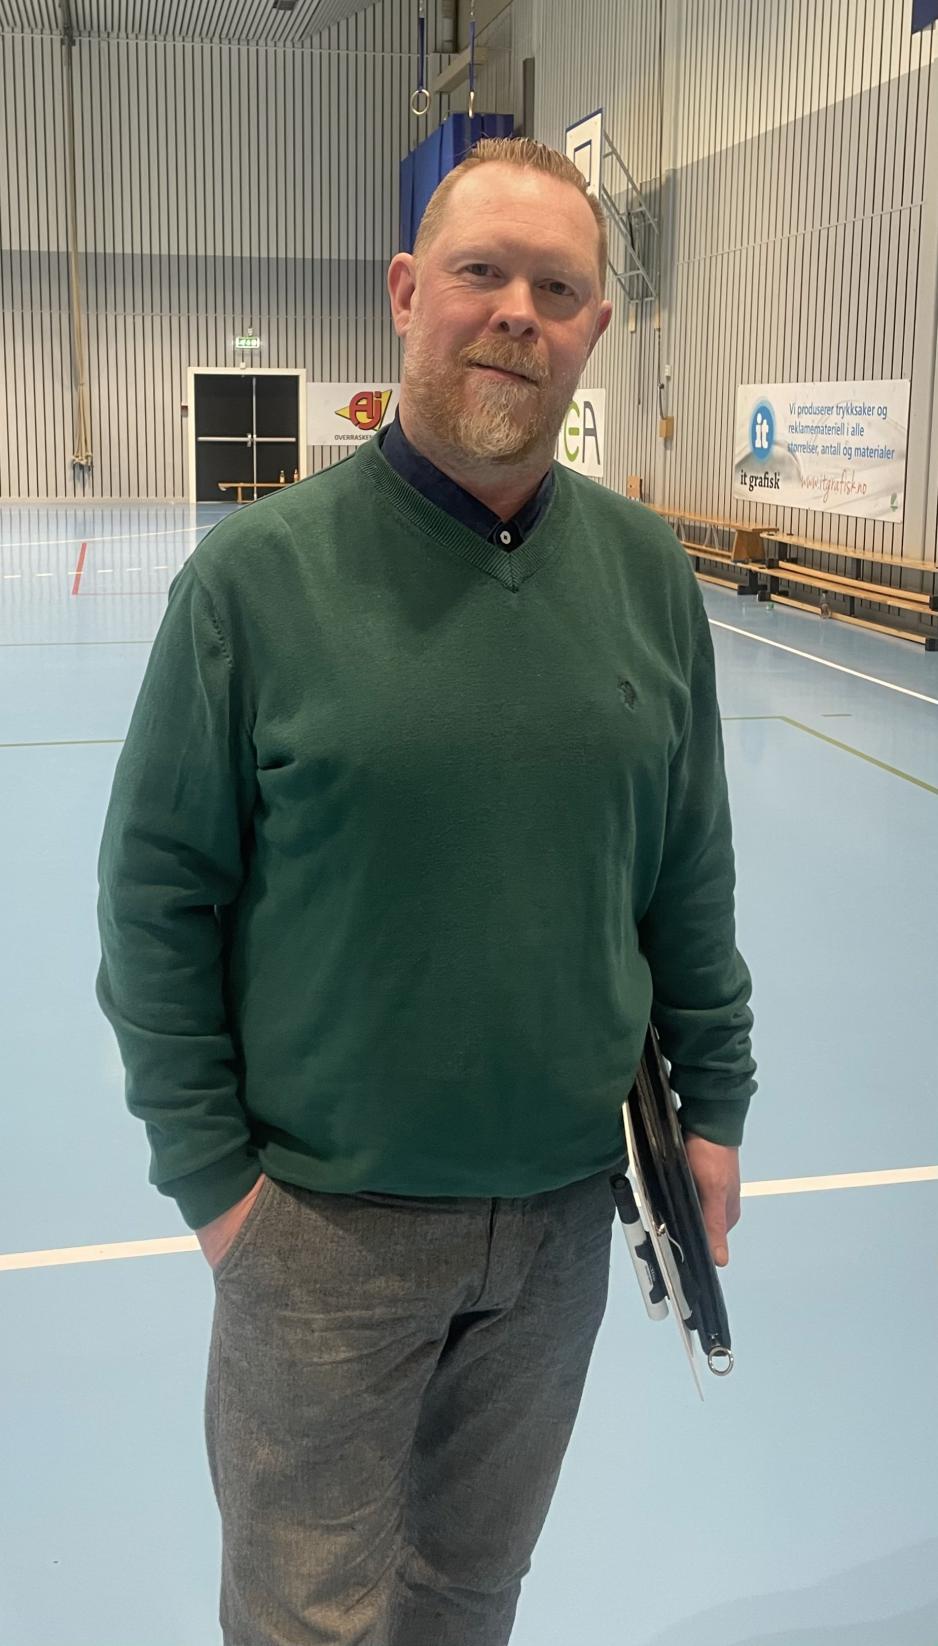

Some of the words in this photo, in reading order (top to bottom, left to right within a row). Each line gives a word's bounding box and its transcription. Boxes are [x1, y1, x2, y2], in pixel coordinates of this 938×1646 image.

[789, 403, 797, 415] Vi
[797, 403, 834, 418] produserer
[835, 403, 875, 418] trykksaker
[876, 406, 888, 419] og
[755, 412, 769, 449] it
[788, 423, 845, 436] reklamemateriell
[846, 424, 850, 436] i
[851, 424, 865, 437] alle
[821, 443, 841, 456] antall
[842, 447, 852, 460] og
[854, 445, 895, 460] materialer
[740, 470, 748, 485] it
[749, 472, 781, 491] grafisk
